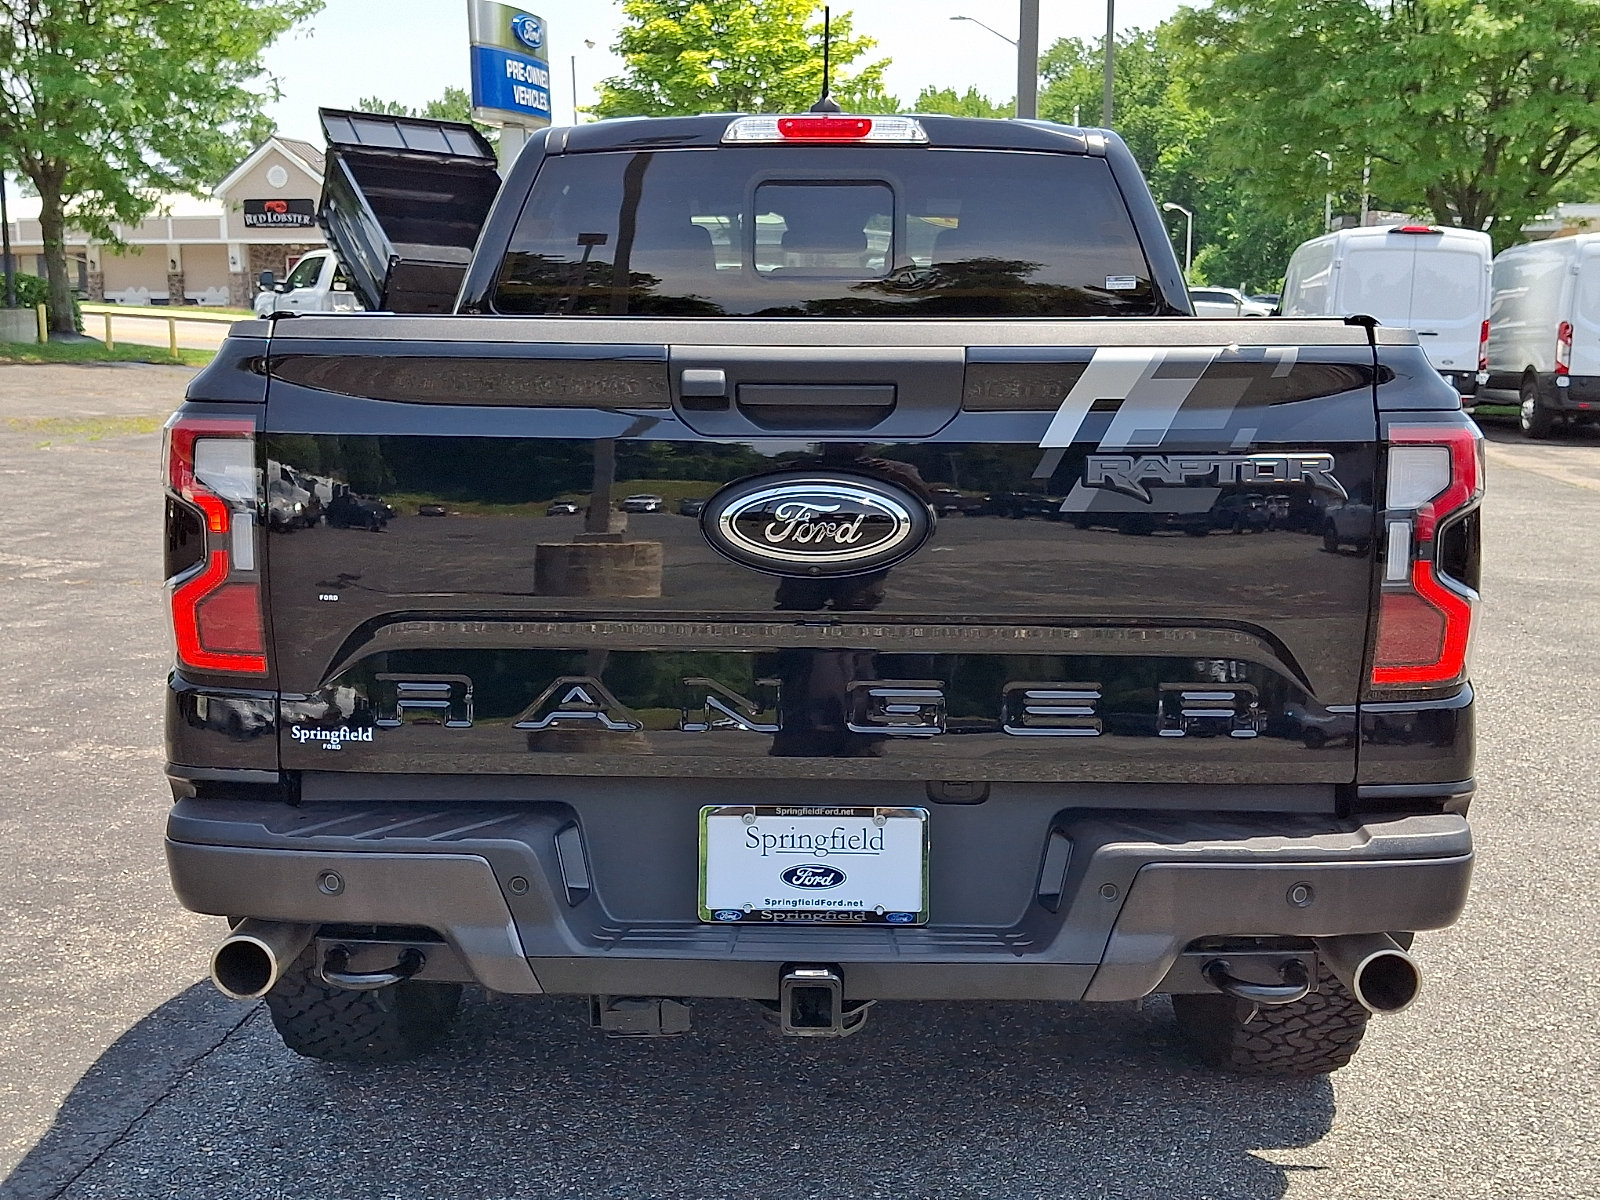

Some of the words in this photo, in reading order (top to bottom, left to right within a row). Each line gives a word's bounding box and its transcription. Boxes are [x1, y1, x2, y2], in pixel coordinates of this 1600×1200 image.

[506, 59, 548, 89] PRE-OWNED
[513, 85, 548, 111] VEHICLES
[245, 213, 266, 225] RED
[266, 211, 310, 225] LOBSTER
[1087, 453, 1349, 503] RAPTOR
[764, 501, 865, 544] Ford
[375, 673, 1260, 738] RANGER
[291, 725, 373, 744] Springfield
[775, 807, 854, 816] SpringfieldFord.net
[745, 826, 885, 857] Springfield
[791, 867, 835, 886] Ford
[764, 898, 864, 907] SpringfieldFord.net
[760, 910, 867, 922] Springfield
